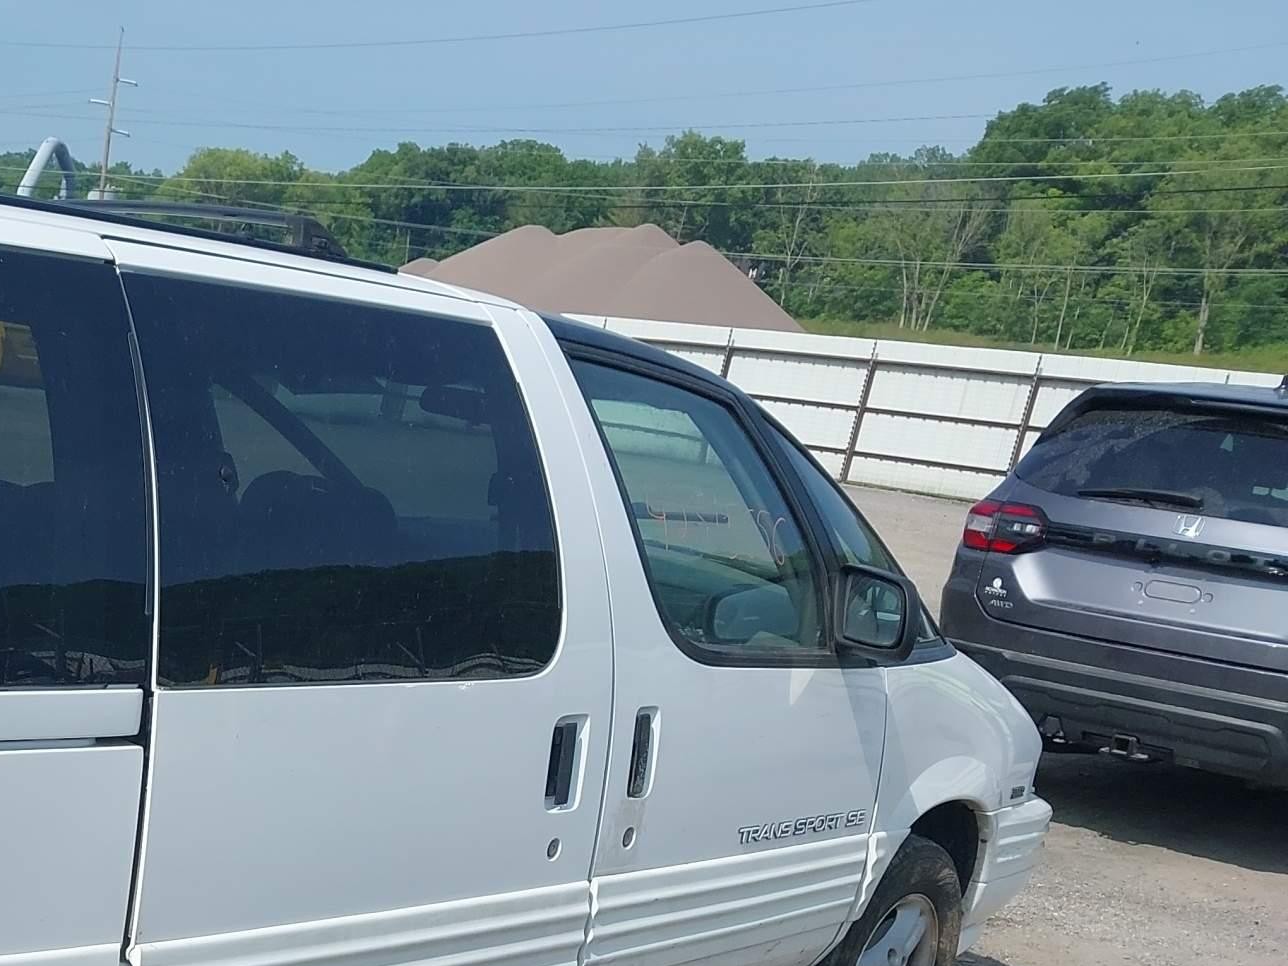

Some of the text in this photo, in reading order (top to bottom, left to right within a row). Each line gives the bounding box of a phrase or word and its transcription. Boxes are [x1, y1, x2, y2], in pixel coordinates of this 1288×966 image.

[1092, 532, 1275, 568] PILOT
[738, 808, 867, 845] TRANS SPORT SE
